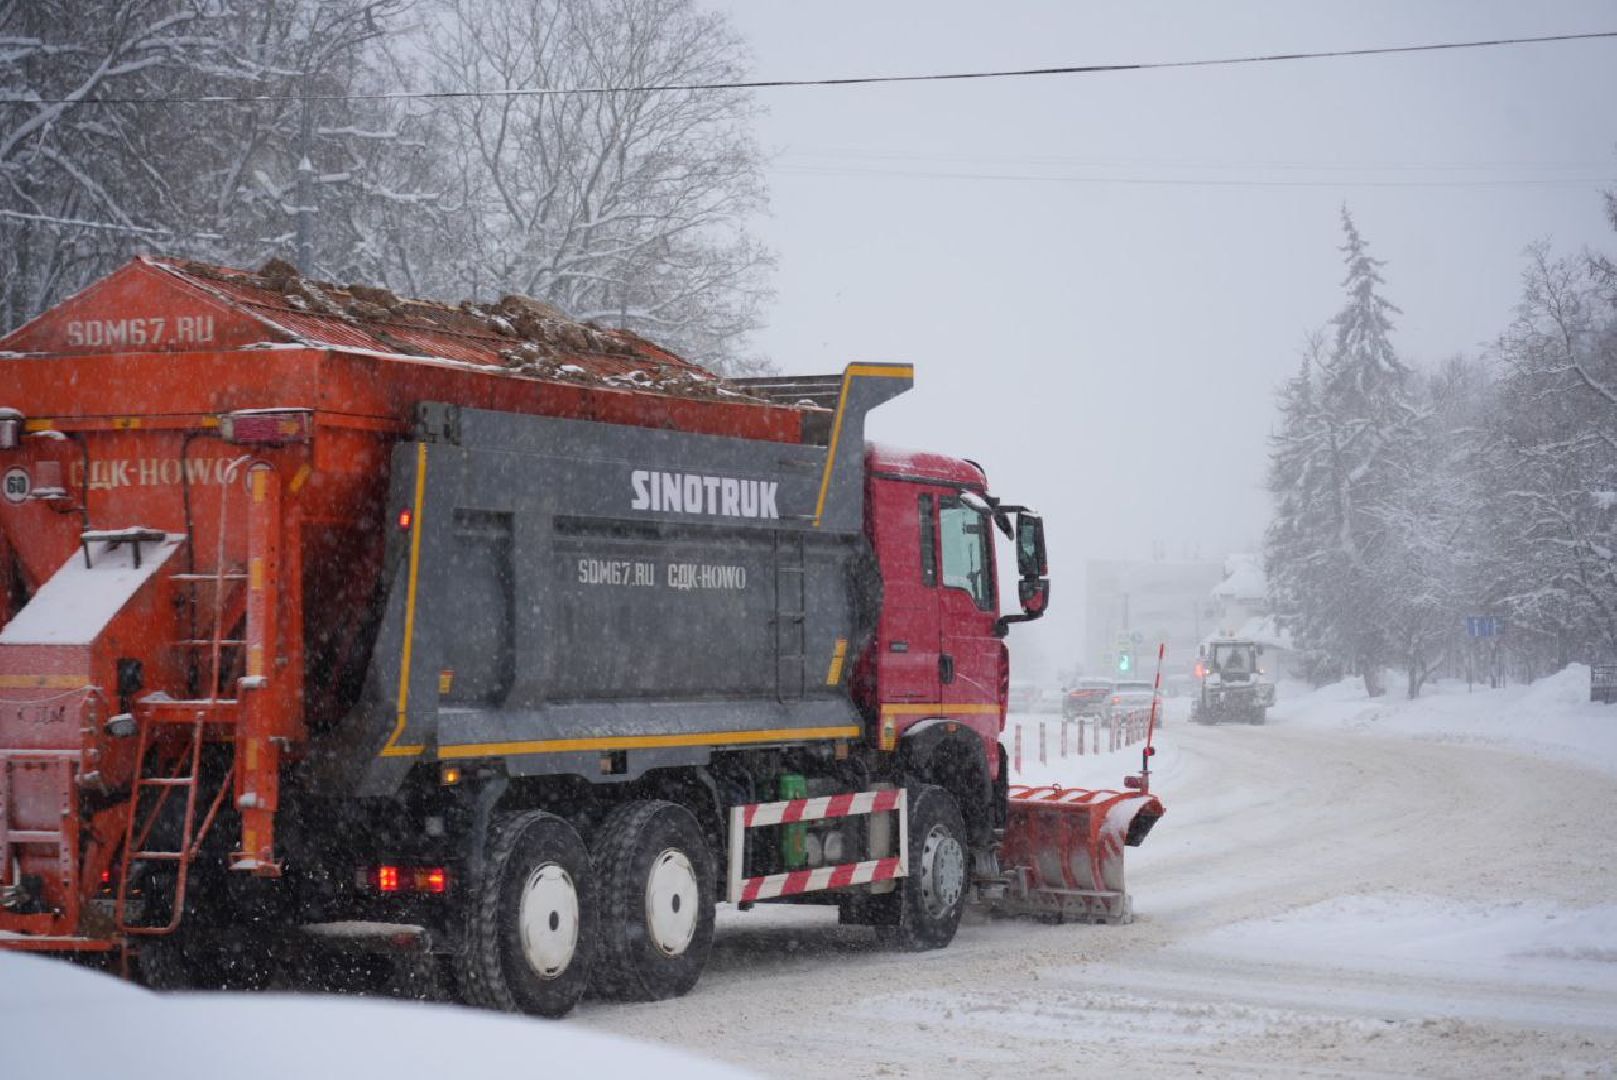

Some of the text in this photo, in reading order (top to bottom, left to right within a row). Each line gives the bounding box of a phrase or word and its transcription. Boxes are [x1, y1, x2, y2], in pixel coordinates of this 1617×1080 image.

[67, 316, 214, 346] SDM67.RU
[631, 470, 779, 519] SINOTRUK
[578, 559, 655, 587] SDM67.RU
